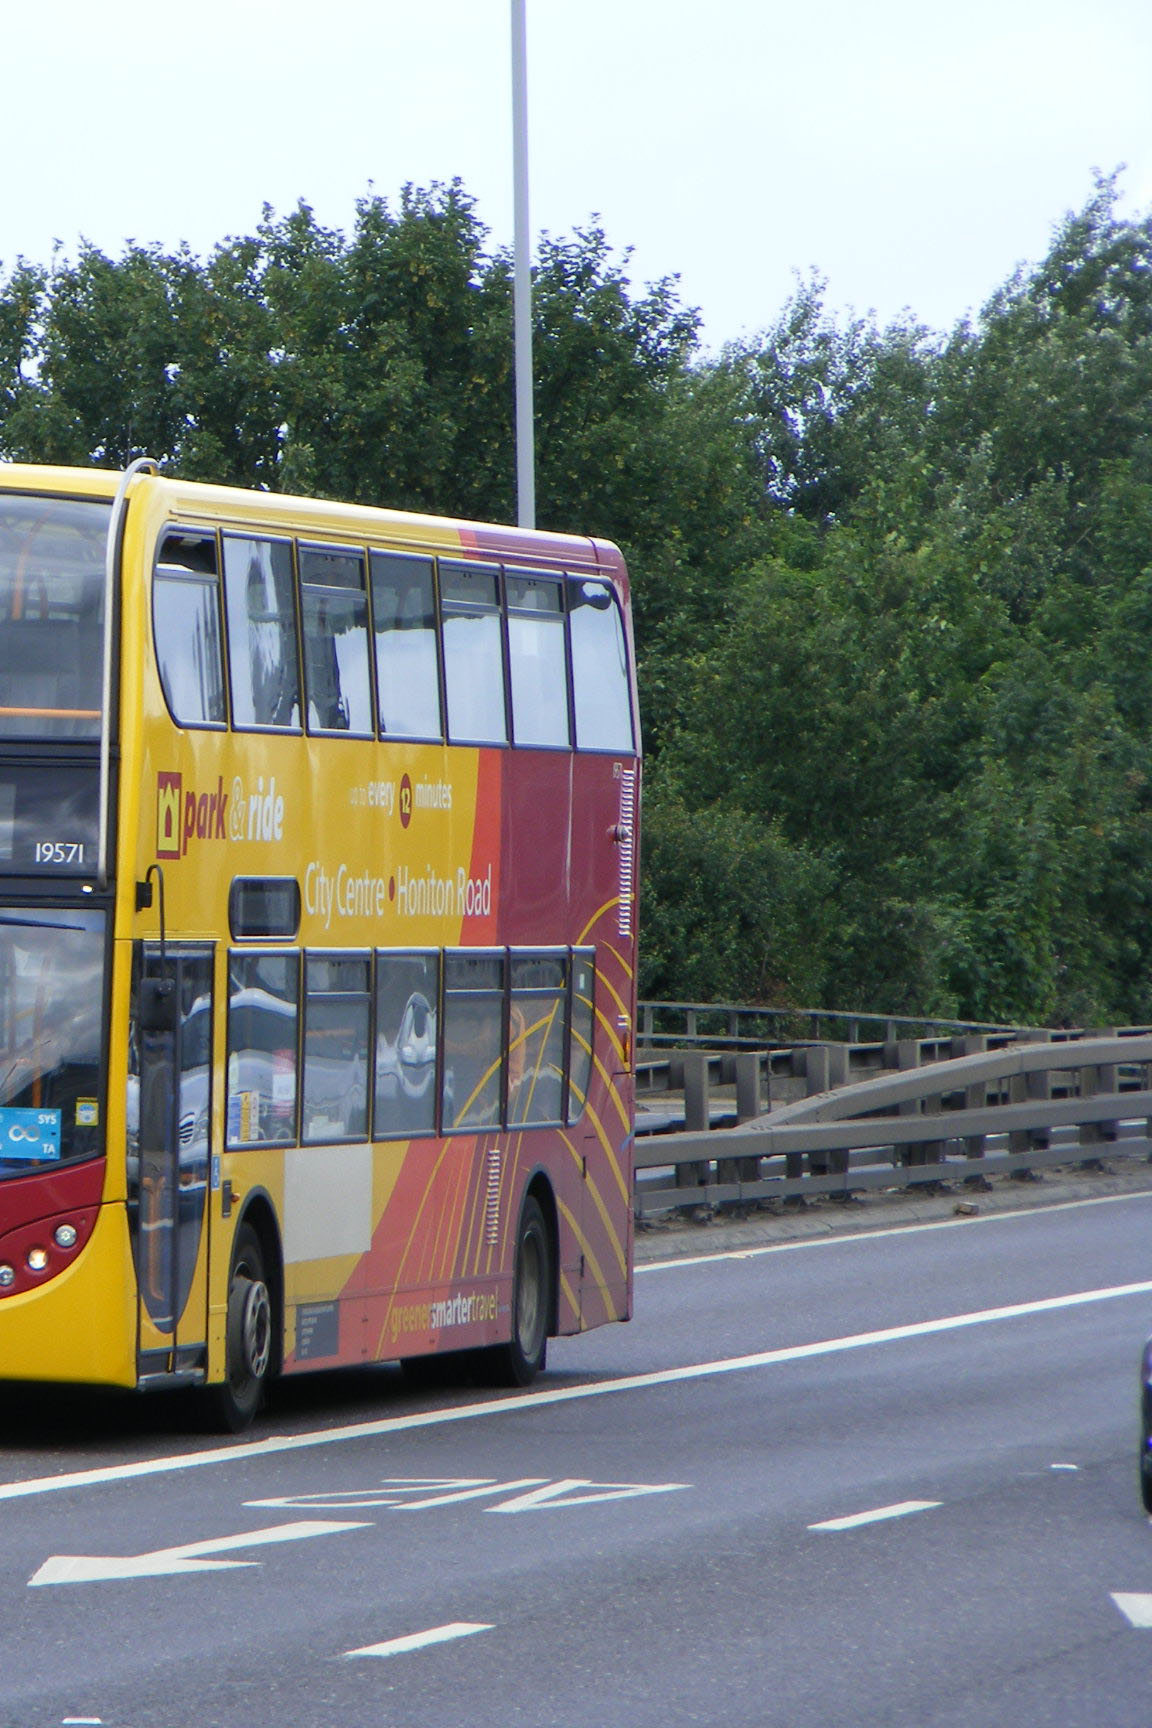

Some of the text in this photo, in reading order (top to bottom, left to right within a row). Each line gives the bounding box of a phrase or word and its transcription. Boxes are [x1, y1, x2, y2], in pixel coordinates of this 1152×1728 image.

[182, 775, 285, 856] park & ride
[368, 781, 396, 817] every
[415, 774, 452, 809] minutes
[35, 842, 84, 864] 19571
[304, 861, 493, 930] City Centre Honiton Road
